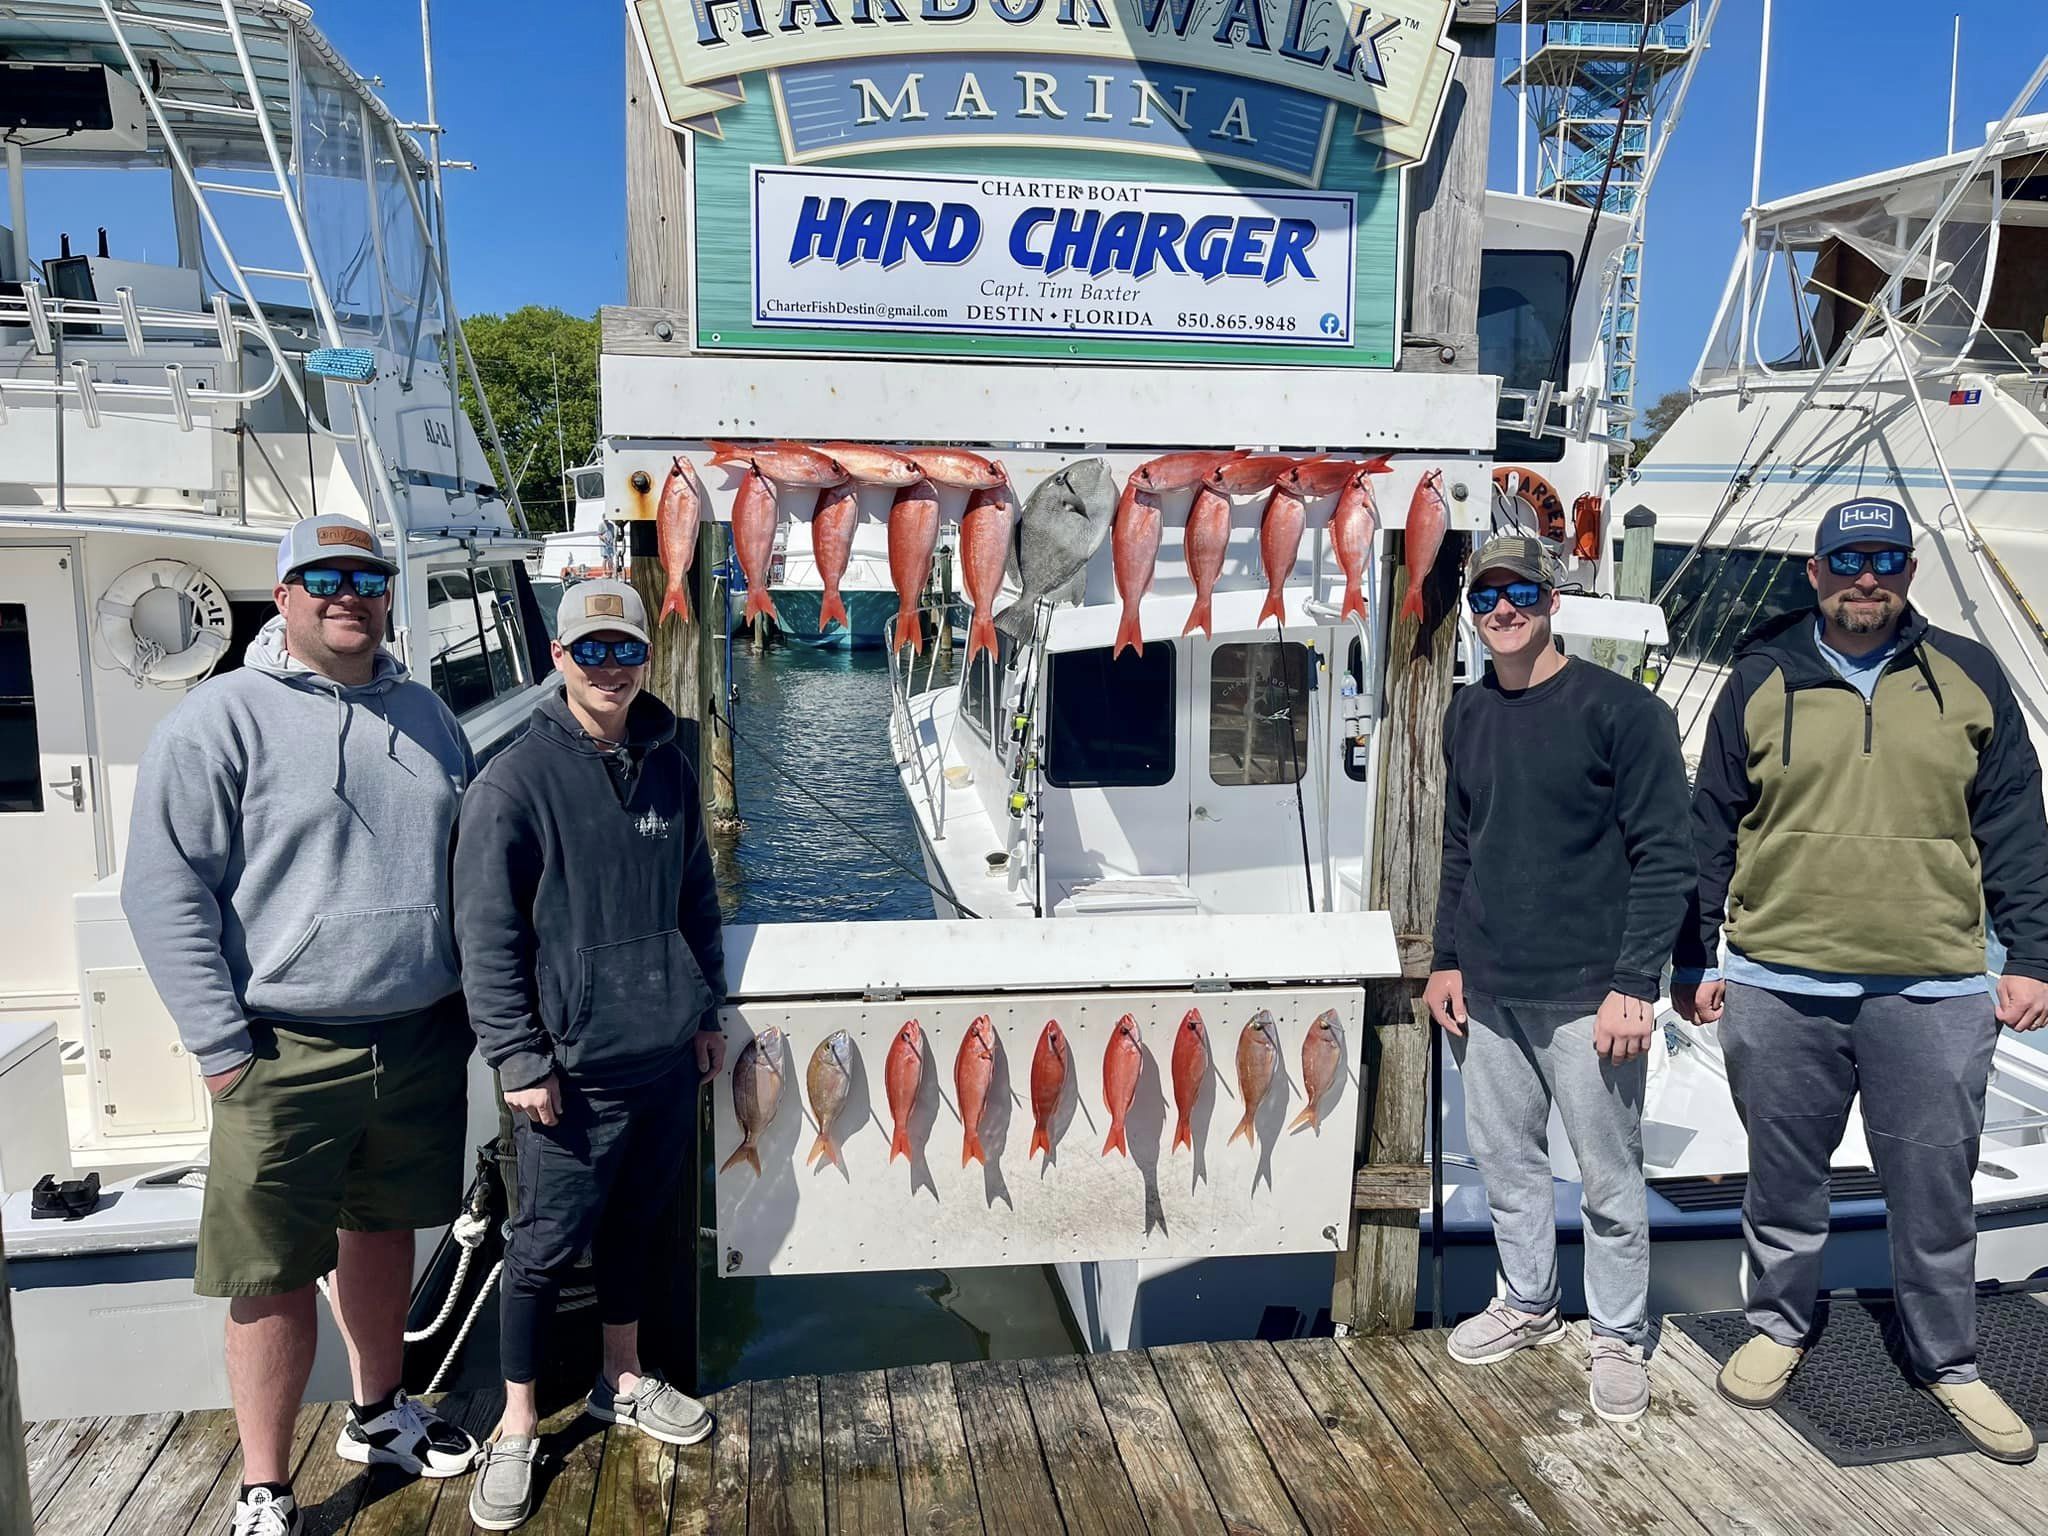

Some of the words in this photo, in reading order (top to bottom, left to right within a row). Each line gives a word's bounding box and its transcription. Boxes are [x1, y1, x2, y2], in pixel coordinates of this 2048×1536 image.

[851, 70, 1259, 145] MARINA
[981, 179, 1081, 200] CHARTER
[1088, 186, 1142, 203] BOAT
[788, 195, 984, 271] HARD
[1008, 206, 1319, 285] CHARGER
[980, 279, 1030, 301] Capt.
[1039, 281, 1073, 299] Tim
[1080, 283, 1141, 302] Baxter
[766, 298, 949, 319] CharterFishDestin@gmail.com
[967, 305, 1044, 322] DESTIN
[1063, 308, 1154, 327] FLORIDA
[1177, 312, 1296, 332] 850.865.9848
